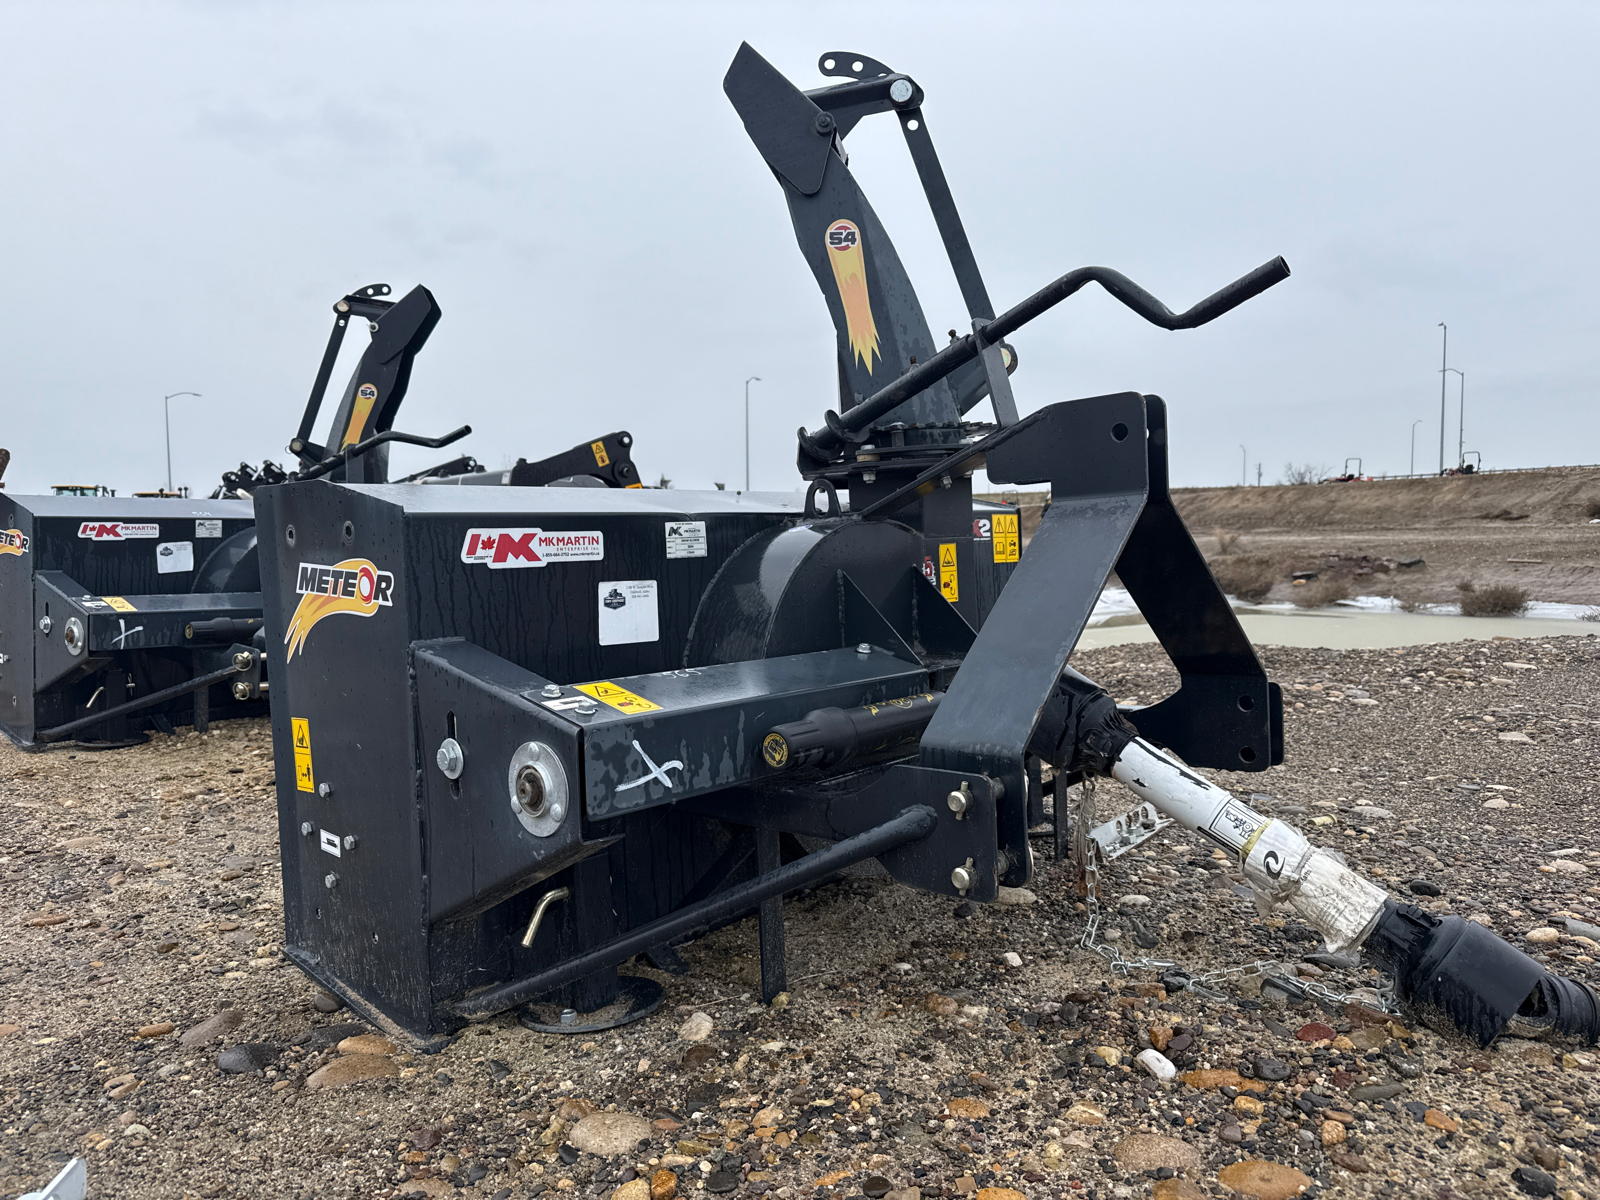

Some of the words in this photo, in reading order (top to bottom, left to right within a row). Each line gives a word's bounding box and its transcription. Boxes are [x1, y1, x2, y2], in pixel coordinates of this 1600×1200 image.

[828, 230, 857, 246] 54
[360, 389, 376, 398] 54
[538, 536, 555, 547] MK
[556, 535, 600, 546] MARTIN
[297, 565, 393, 605] METEOR
